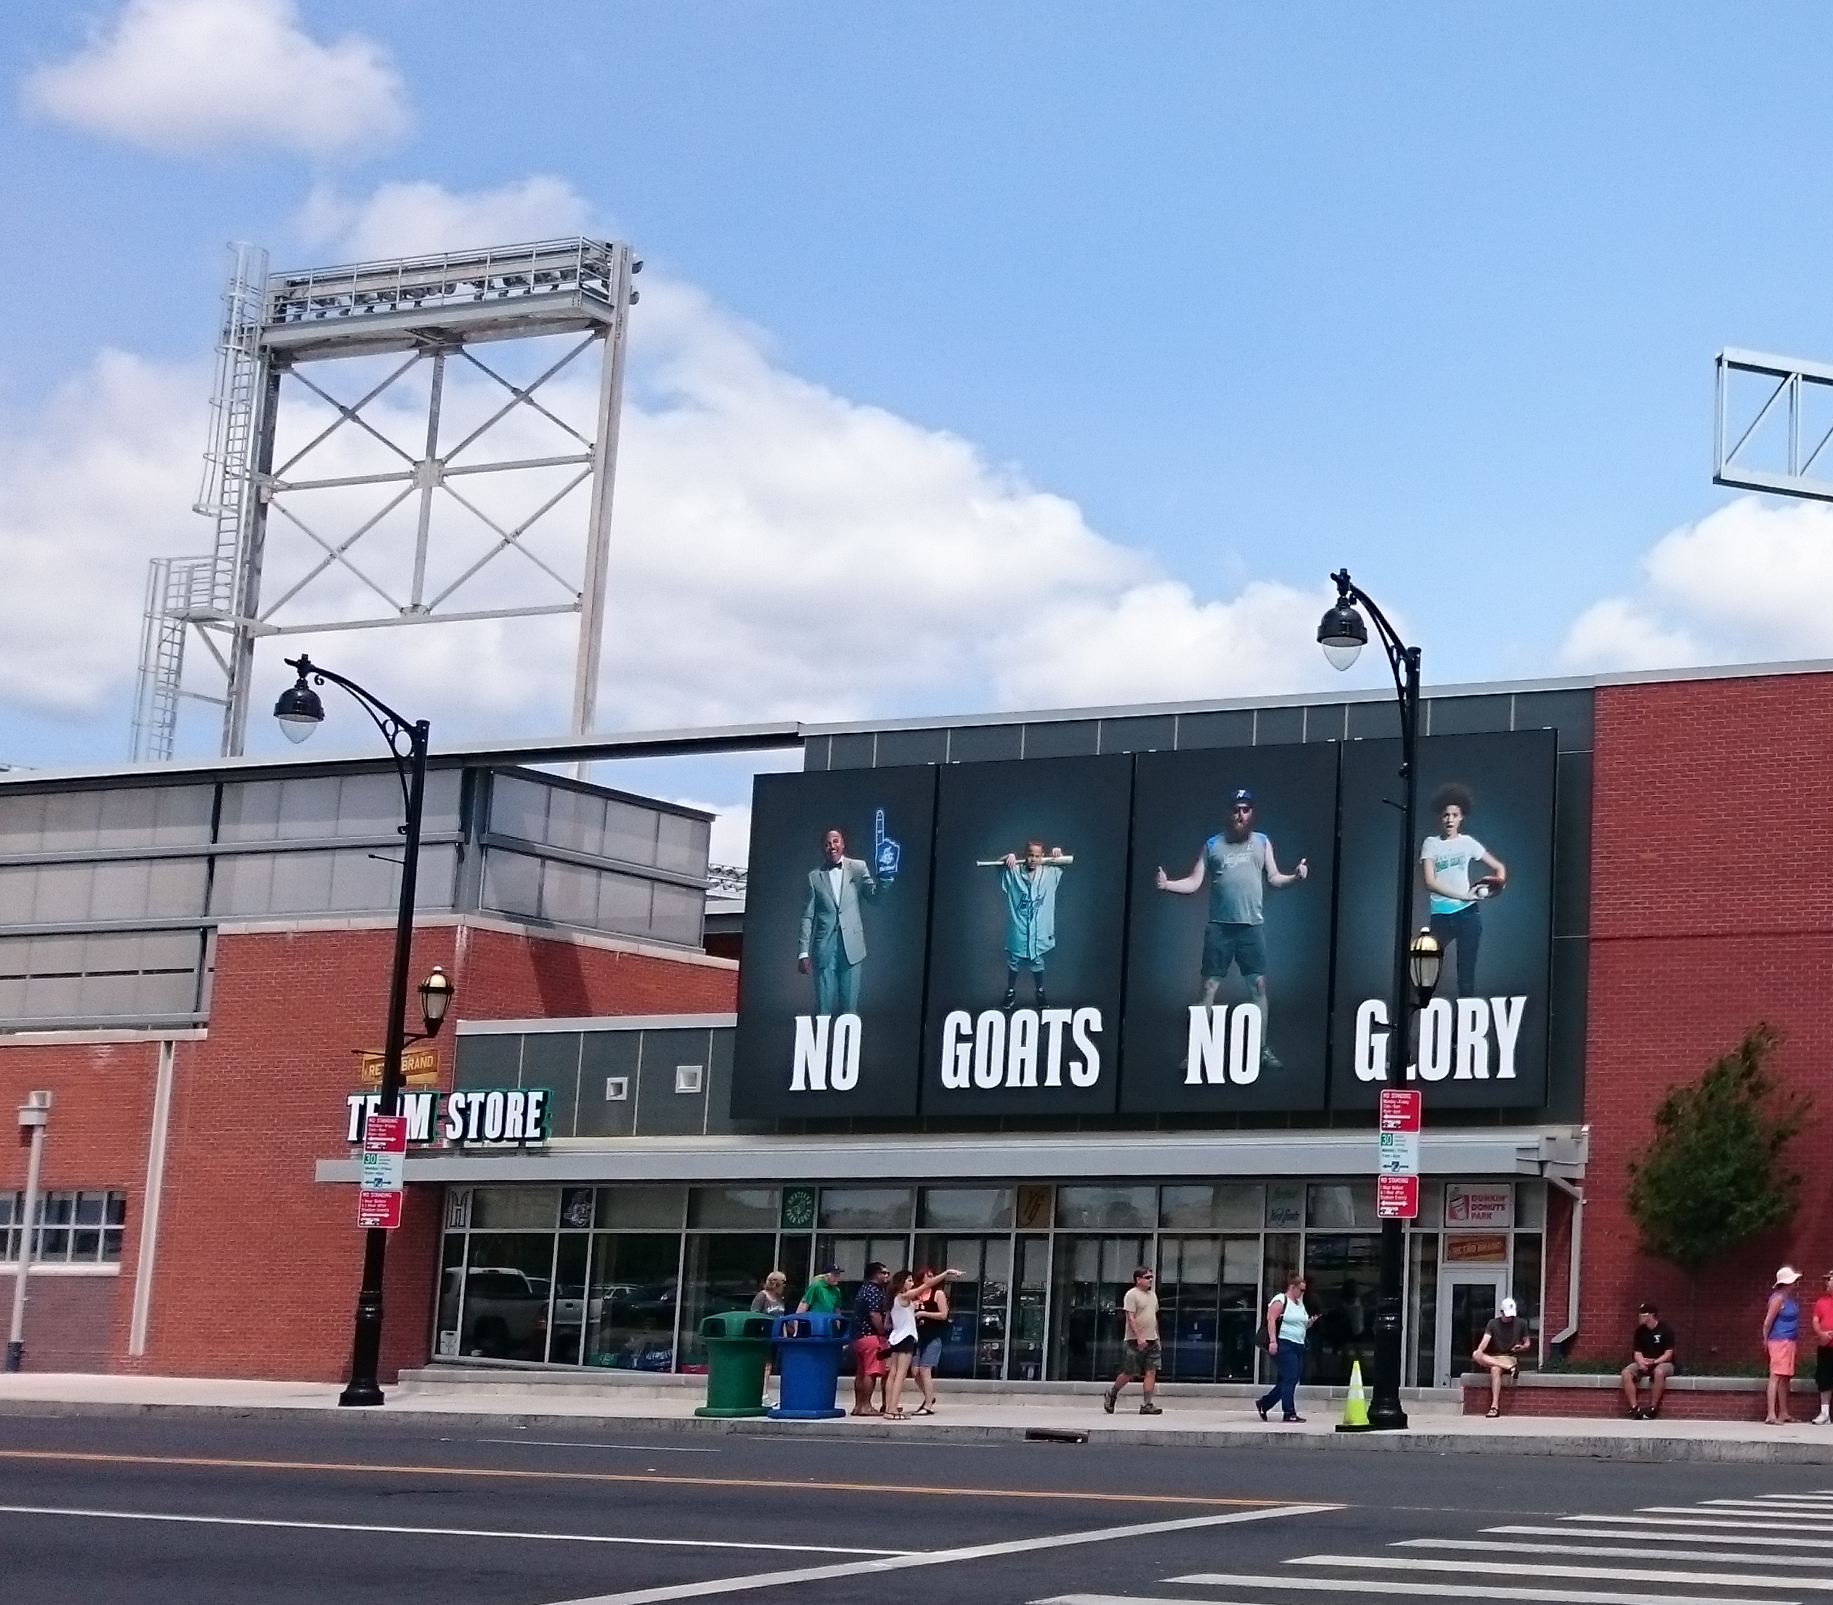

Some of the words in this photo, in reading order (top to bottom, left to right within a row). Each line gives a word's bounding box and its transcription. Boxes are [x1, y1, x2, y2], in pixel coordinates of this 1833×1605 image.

[789, 1014, 862, 1091] NO
[941, 1007, 1103, 1089] GOATS
[1184, 1003, 1262, 1085] NO
[1354, 996, 1528, 1082] GORY
[401, 1056, 434, 1072] BRAND
[347, 1092, 433, 1140] TM
[445, 1091, 544, 1140] STORE
[1382, 1134, 1392, 1146] 30
[365, 1153, 376, 1164] 30
[1471, 1203, 1506, 1211] DONUTS
[1471, 1212, 1492, 1220] PARK
